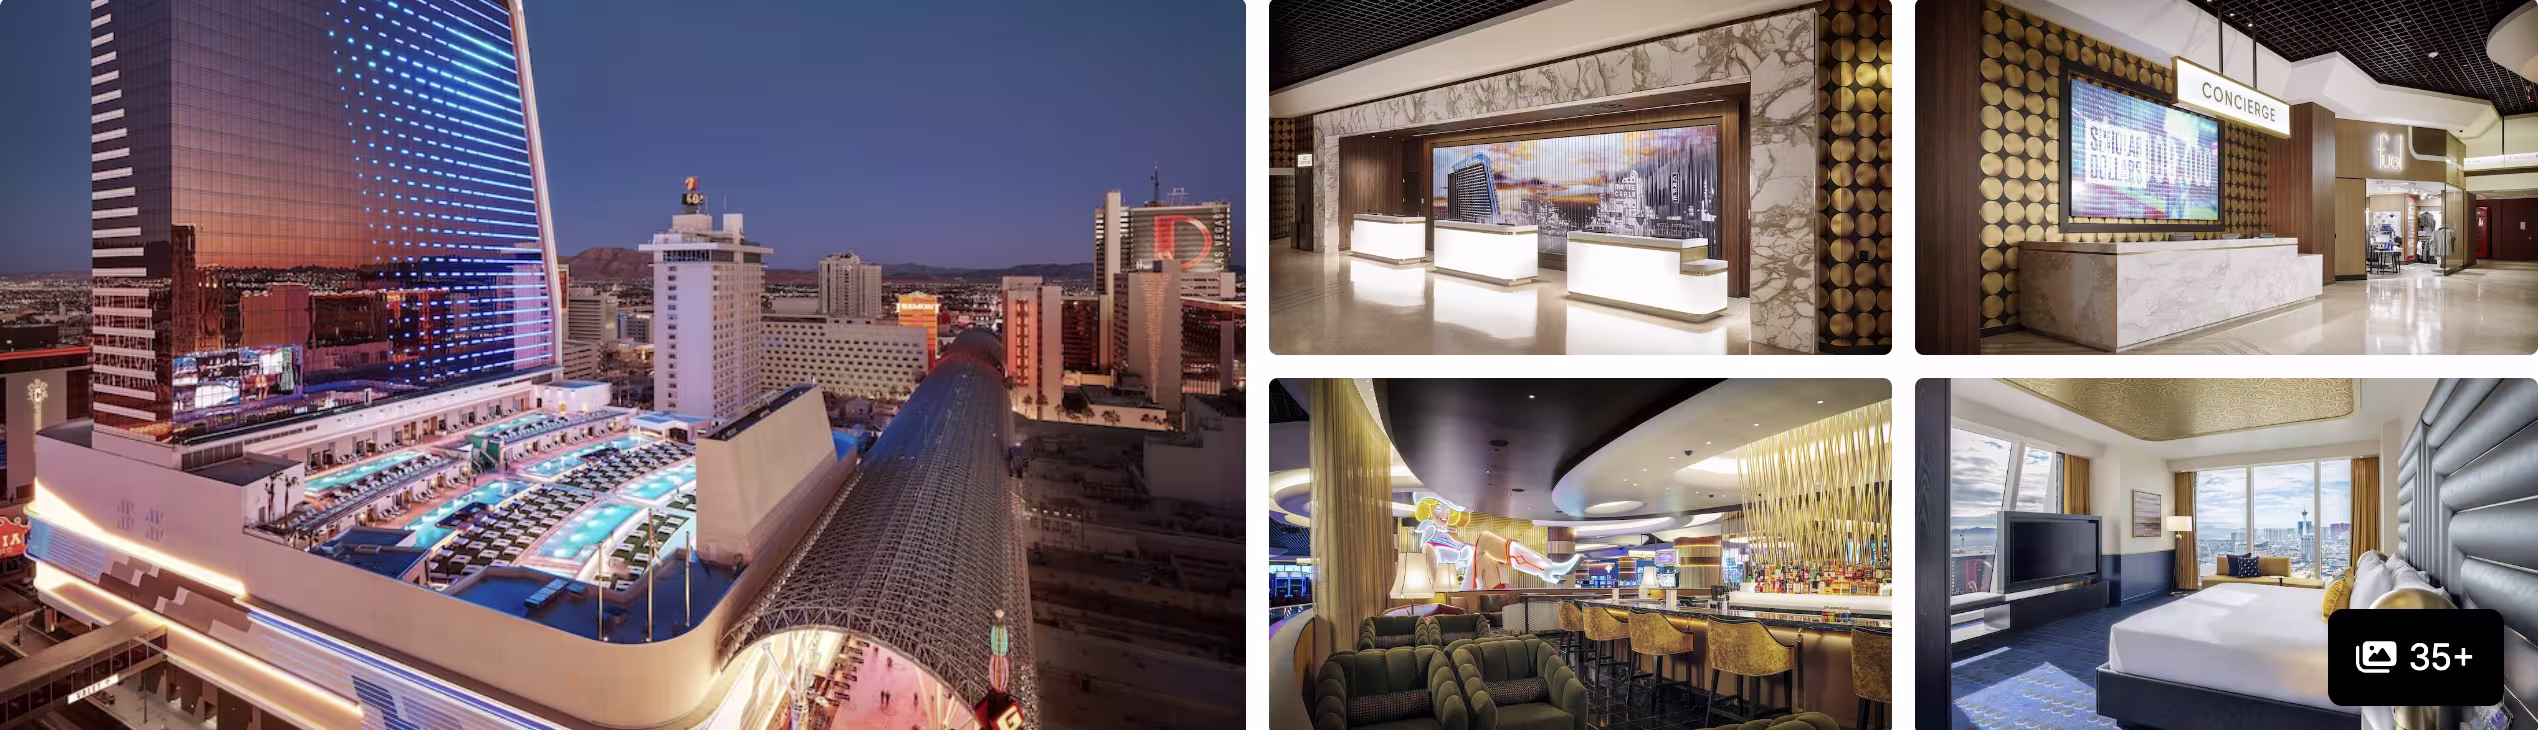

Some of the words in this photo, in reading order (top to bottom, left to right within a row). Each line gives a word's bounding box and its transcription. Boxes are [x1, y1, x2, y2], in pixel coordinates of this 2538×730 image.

[2202, 82, 2276, 122] CONCIERGE
[2376, 132, 2403, 170] fuel
[1213, 213, 1225, 250] VEGAS
[1214, 251, 1225, 272] LAS
